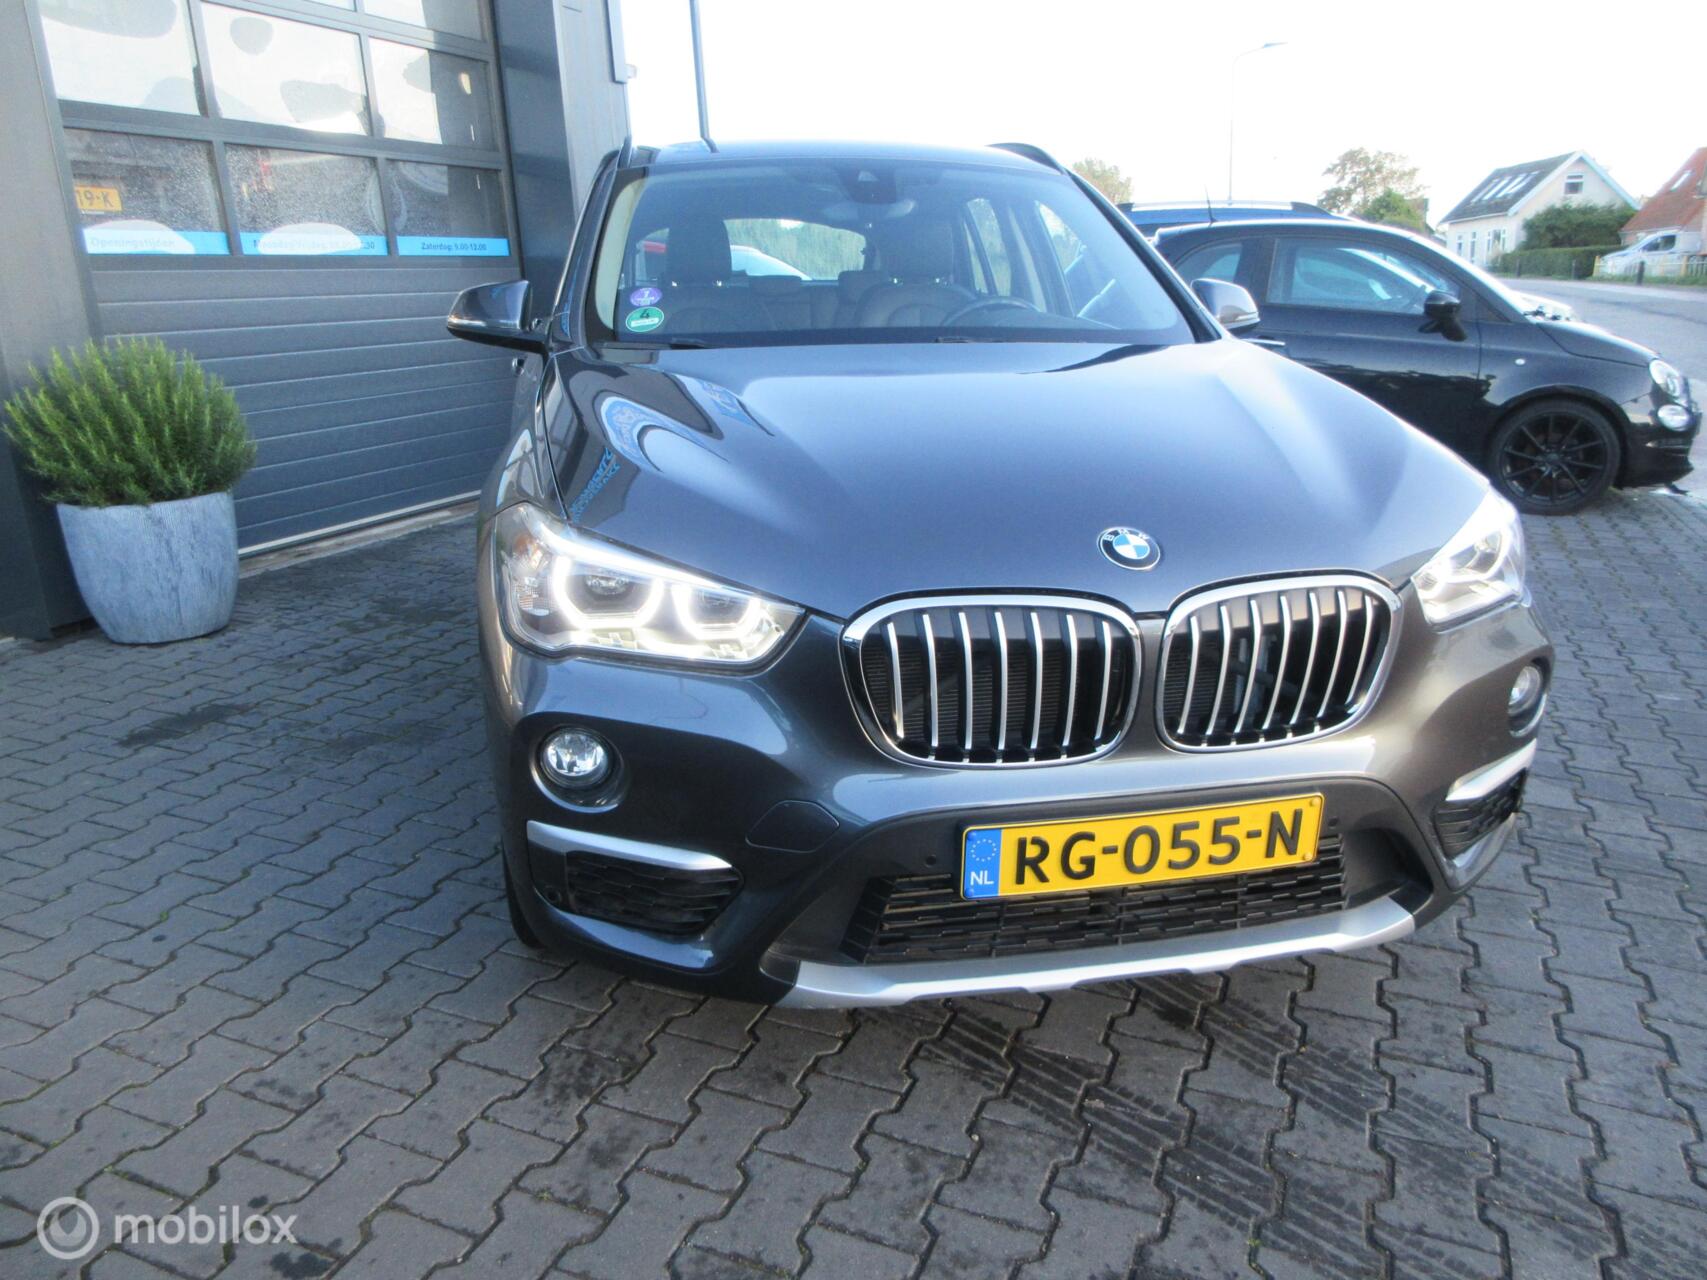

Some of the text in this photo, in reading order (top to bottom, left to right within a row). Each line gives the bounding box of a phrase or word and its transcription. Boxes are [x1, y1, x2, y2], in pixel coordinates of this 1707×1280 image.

[1102, 528, 1150, 541] BMW
[1015, 807, 1303, 885] RG-055-N
[969, 871, 994, 886] NL
